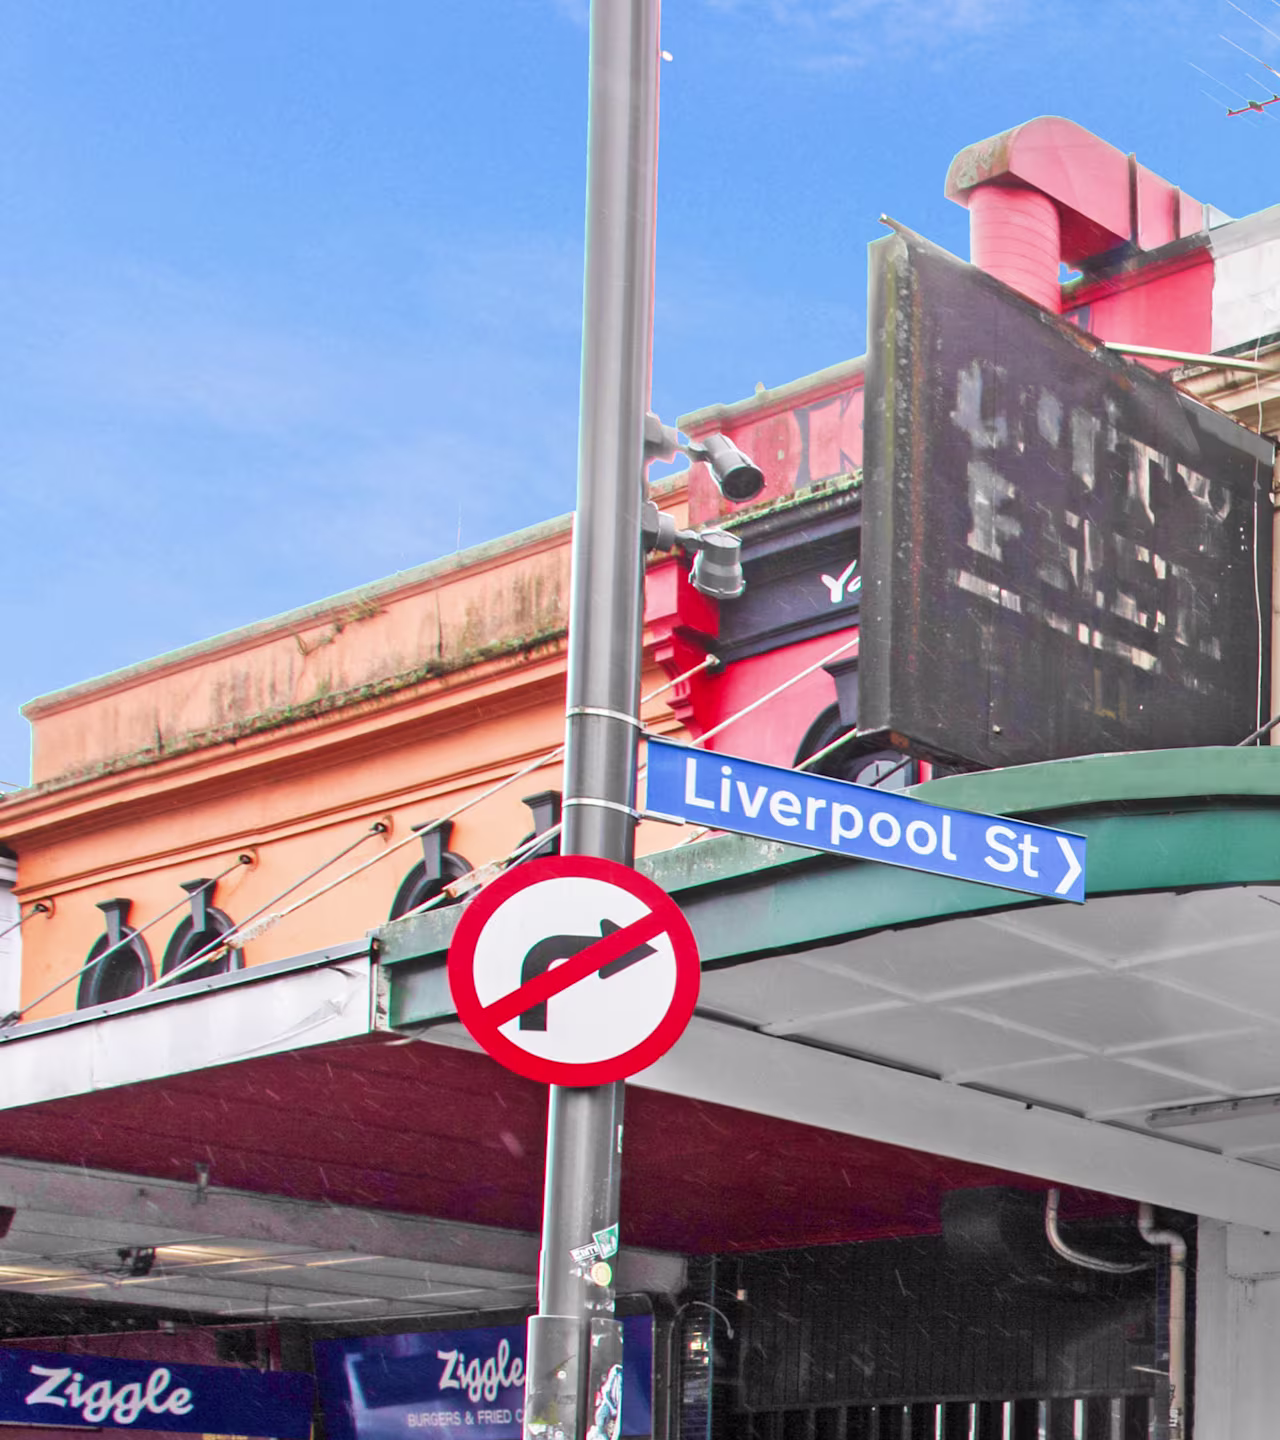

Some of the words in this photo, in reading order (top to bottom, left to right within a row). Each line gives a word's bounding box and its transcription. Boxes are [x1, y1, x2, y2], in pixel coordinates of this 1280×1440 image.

[684, 758, 957, 861] Liverpool
[983, 825, 1040, 878] St
[25, 1364, 194, 1424] Ziggle
[437, 1338, 526, 1402] Ziggle
[407, 1409, 462, 1428] BURGERS
[465, 1411, 475, 1426] &
[477, 1408, 512, 1425] FRIED
